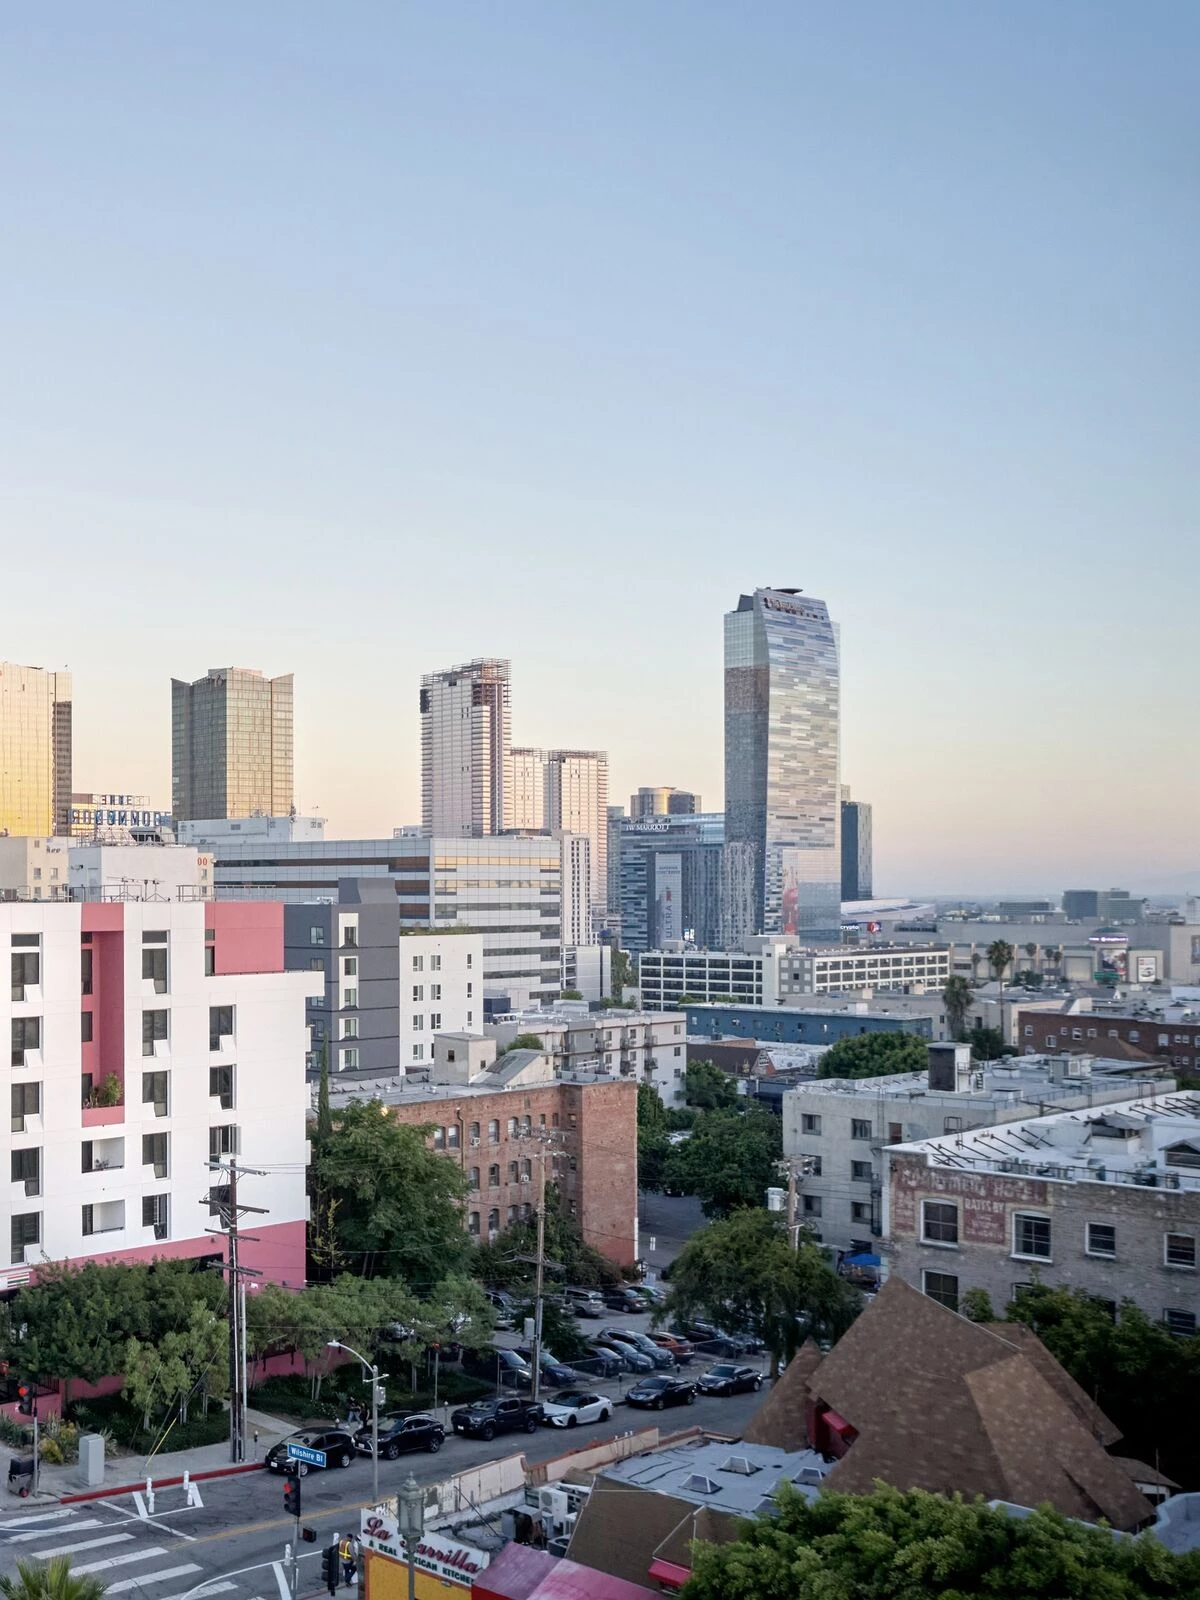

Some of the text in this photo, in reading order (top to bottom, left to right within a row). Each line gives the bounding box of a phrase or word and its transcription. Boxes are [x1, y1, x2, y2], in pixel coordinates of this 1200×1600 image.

[636, 823, 670, 832] MARRIOTT
[665, 904, 673, 938] ULTRA
[291, 1447, 323, 1462] Wilshire Bl
[362, 1517, 484, 1574] La arrilla
[368, 1540, 374, 1548] A
[378, 1543, 397, 1556] REAL
[402, 1552, 438, 1571] MXICAN
